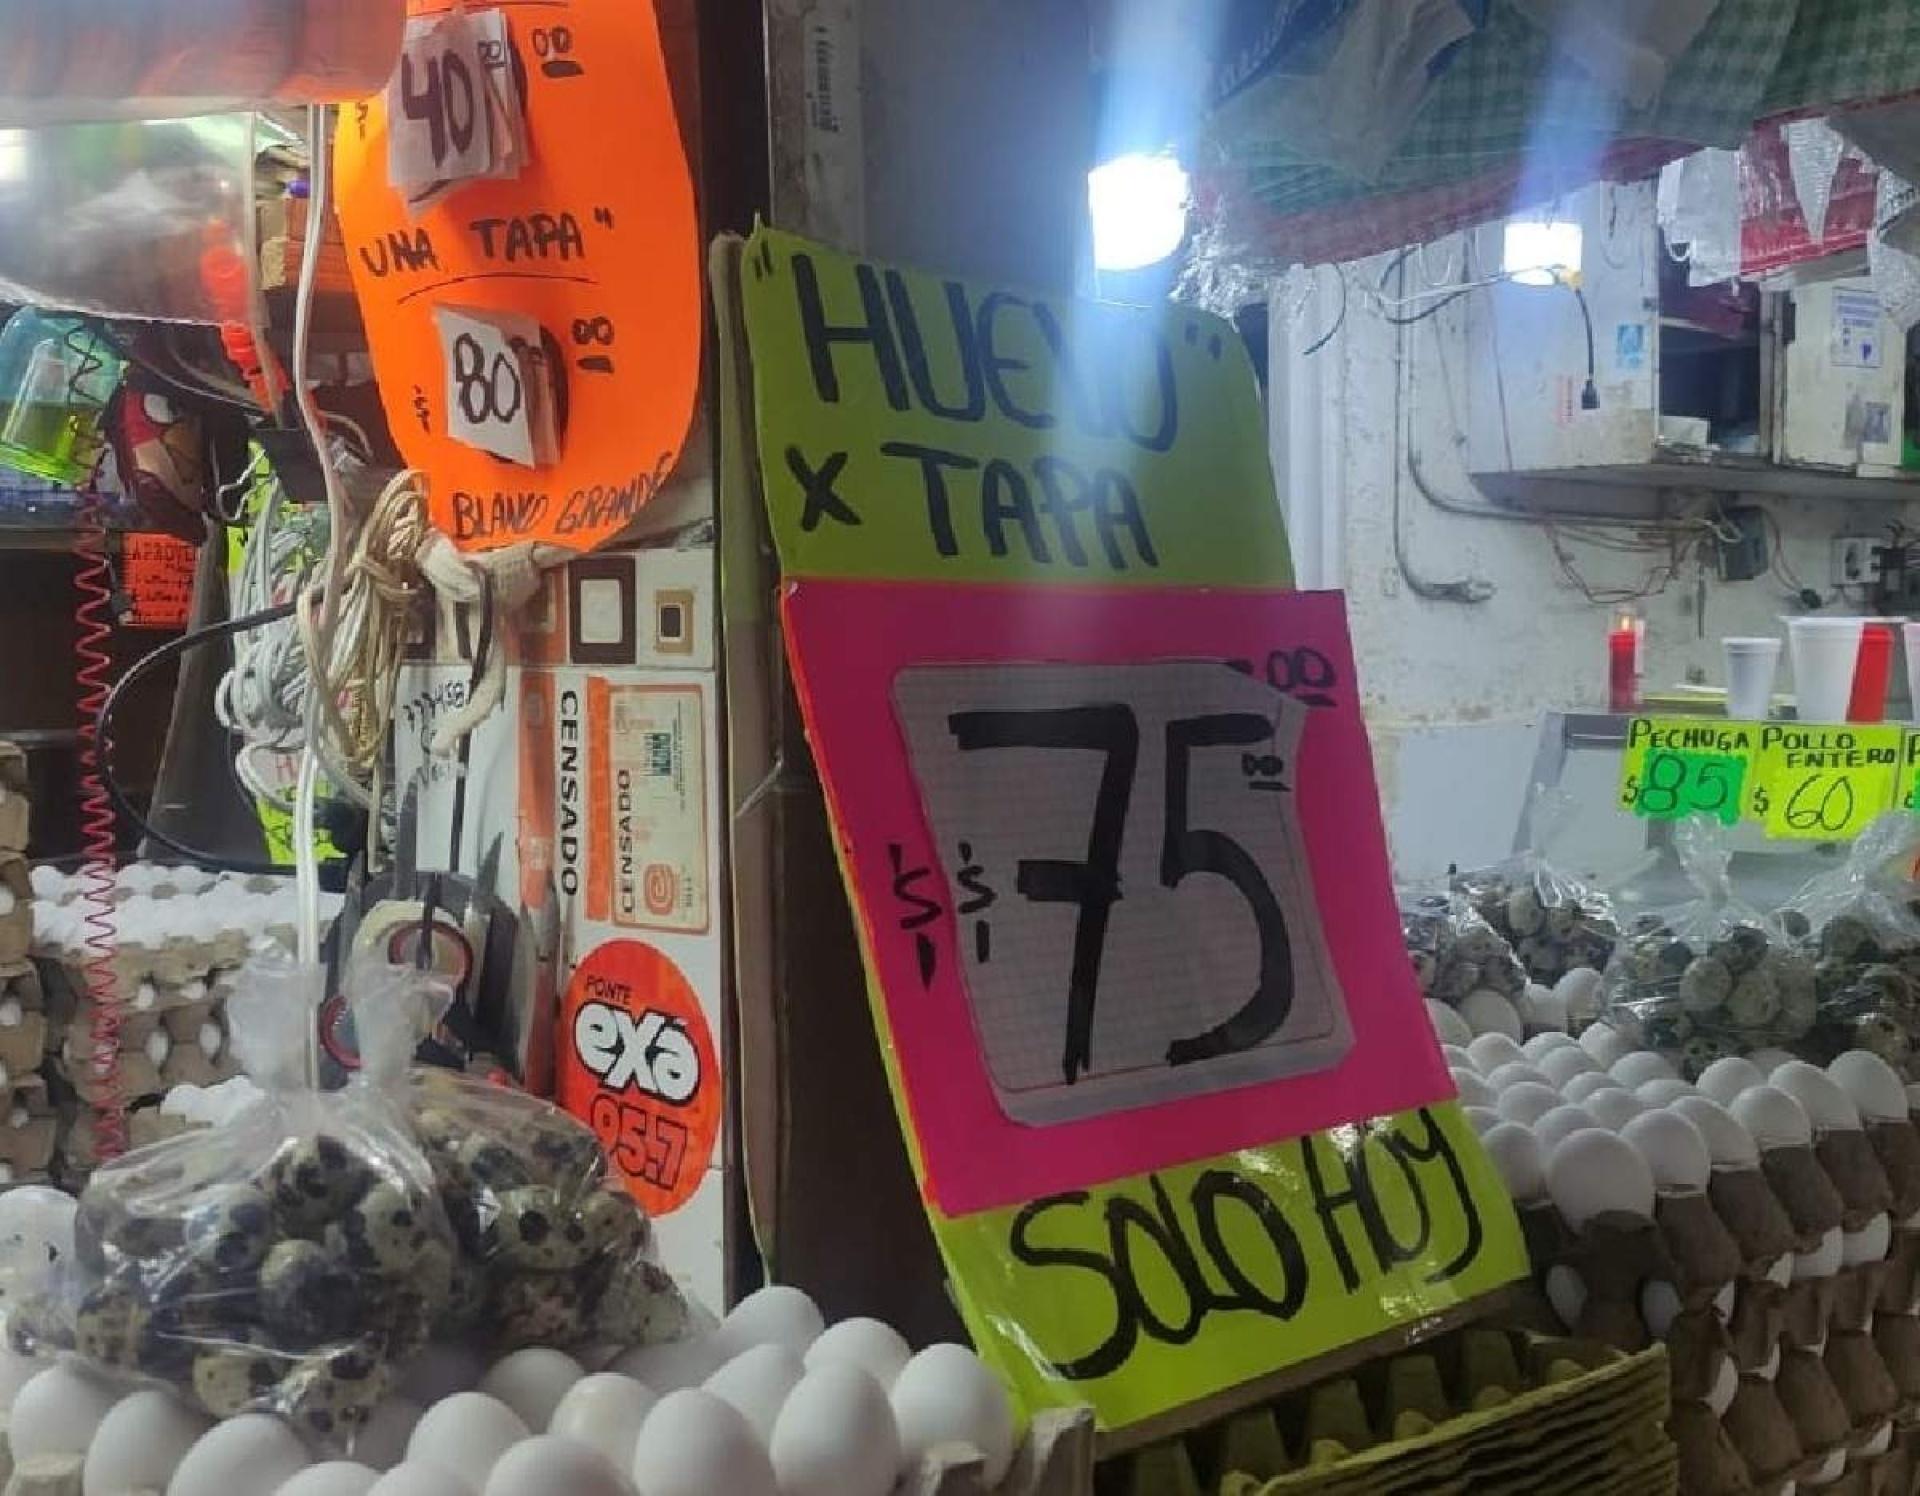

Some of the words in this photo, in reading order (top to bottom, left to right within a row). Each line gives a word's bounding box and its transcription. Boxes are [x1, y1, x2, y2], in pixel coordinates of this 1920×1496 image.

[531, 26, 572, 56] 00
[402, 52, 474, 168] 40
[360, 228, 438, 278] UNA
[453, 332, 521, 424] 80
[571, 316, 614, 345] 00
[880, 441, 1160, 570] TAPA
[1266, 646, 1337, 691] 00
[1628, 719, 1750, 751] PECHUGA
[1762, 727, 1856, 750] POLLO
[1786, 748, 1895, 769] ENTERO
[561, 690, 579, 897] CENSADO
[617, 769, 637, 914] CENSADO
[948, 703, 1295, 1086] 75
[586, 974, 633, 1005] PONTE
[1009, 1168, 1309, 1381] SOLO
[1301, 1106, 1483, 1296] HOY
